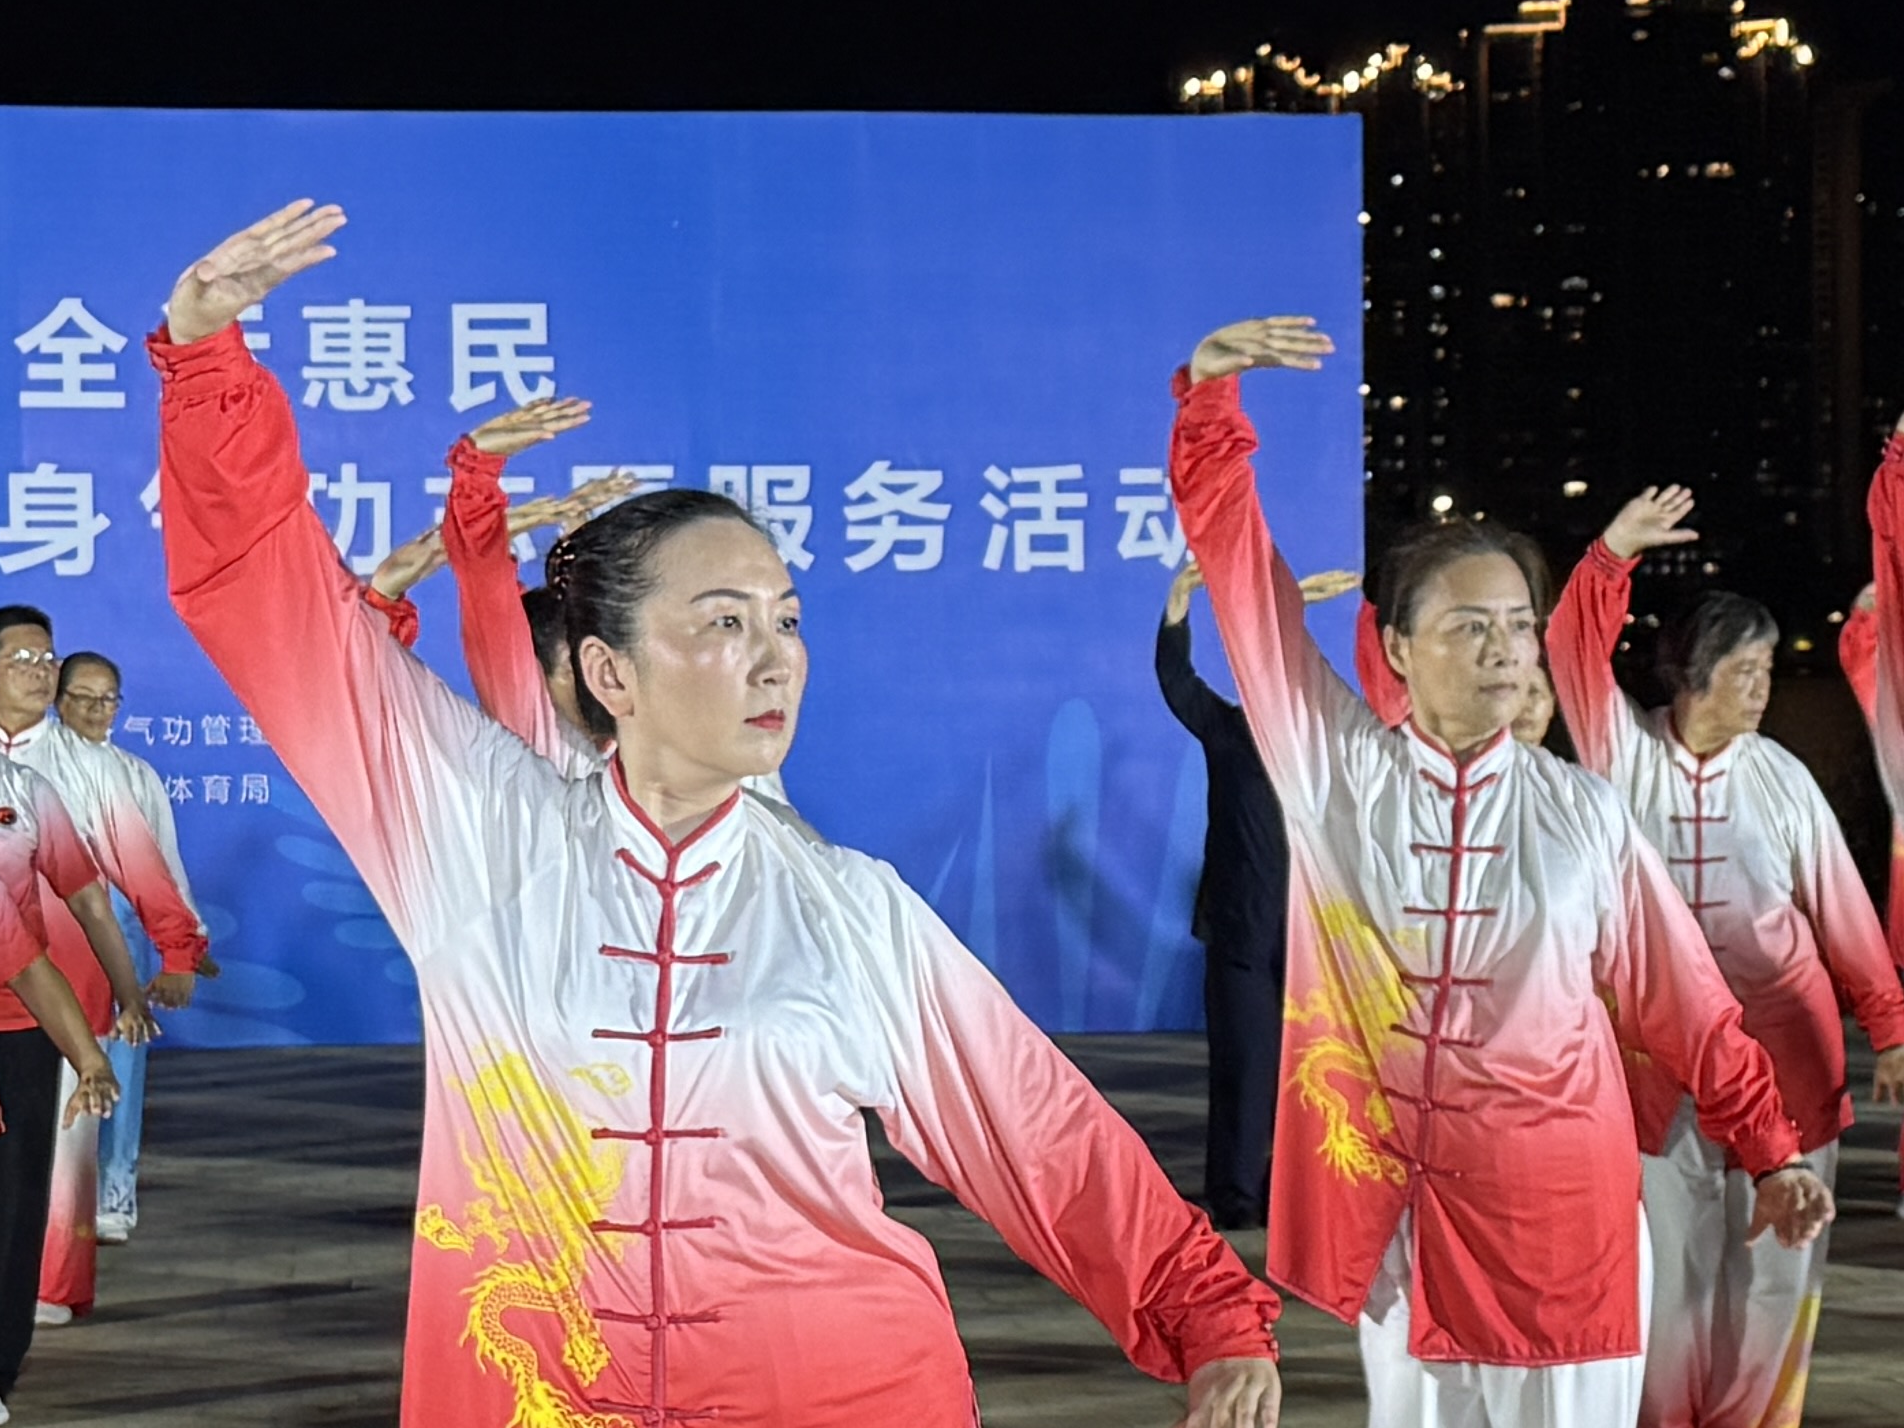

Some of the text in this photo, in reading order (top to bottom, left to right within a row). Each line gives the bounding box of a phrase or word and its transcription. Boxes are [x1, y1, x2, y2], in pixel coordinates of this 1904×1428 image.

[13, 297, 556, 413] 全惠民
[165, 773, 270, 806] 体育局
